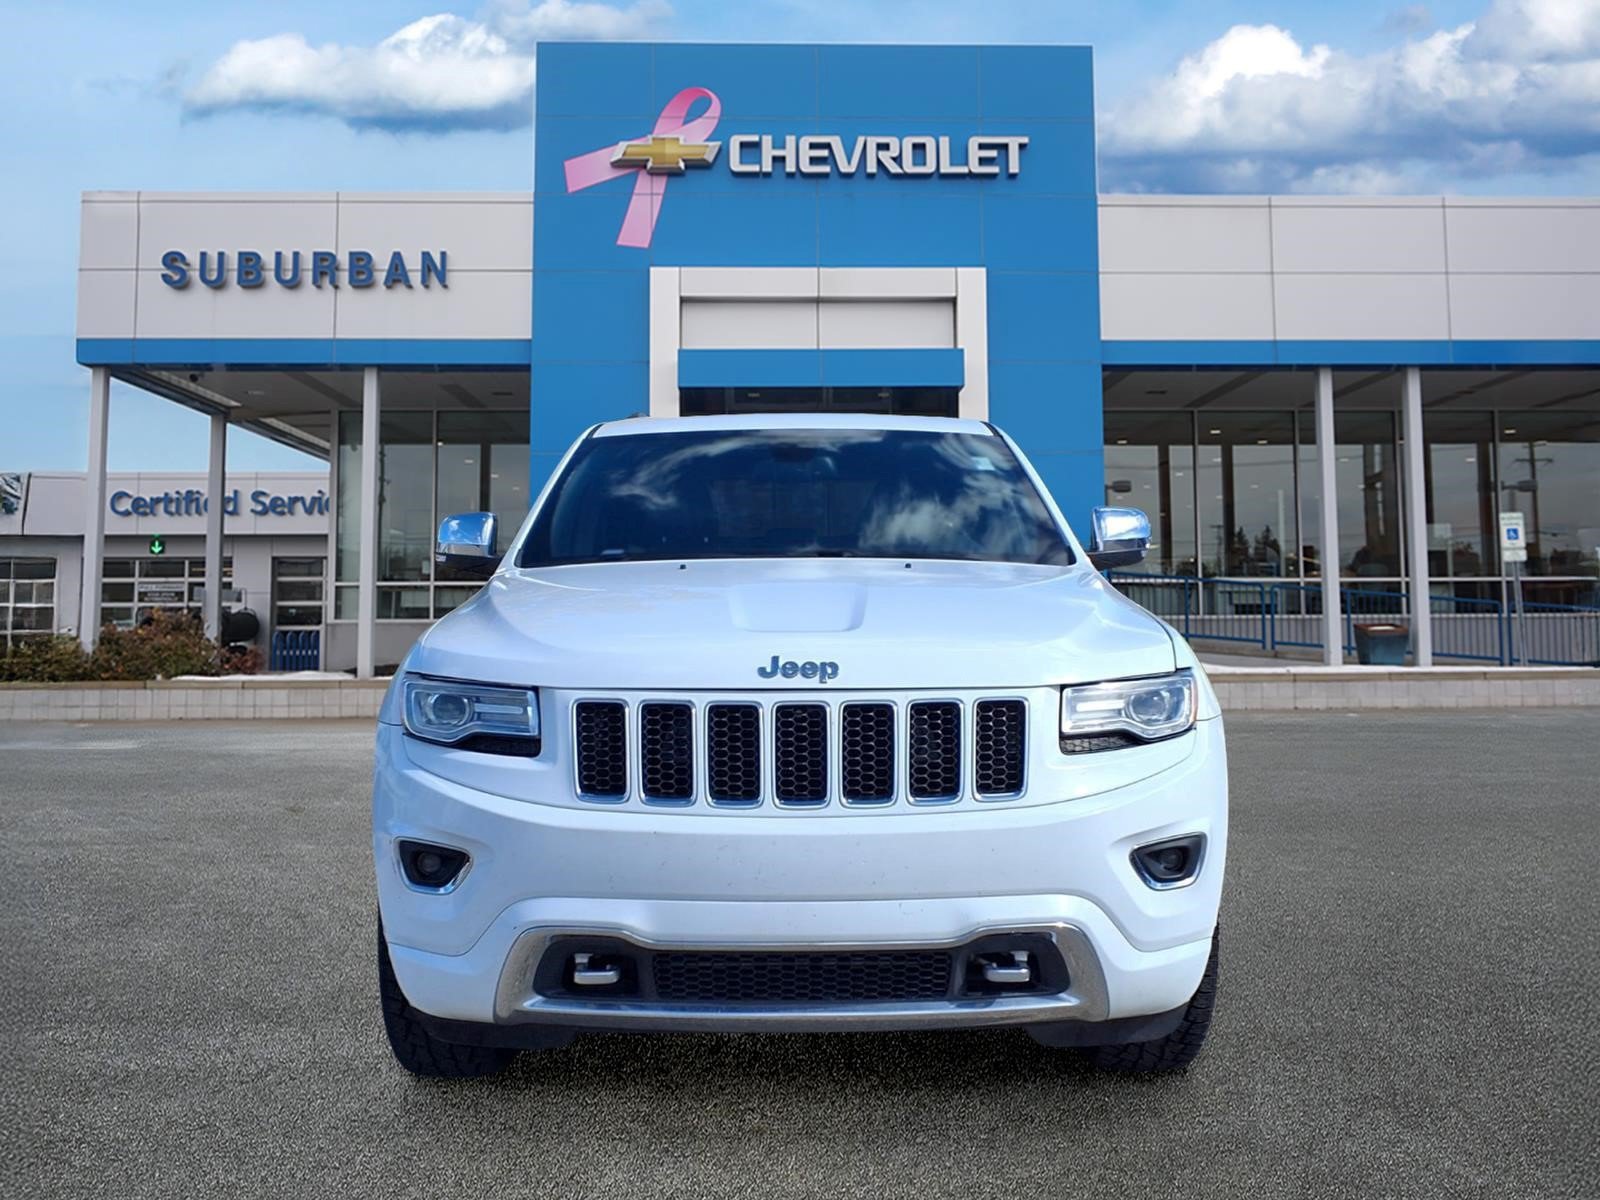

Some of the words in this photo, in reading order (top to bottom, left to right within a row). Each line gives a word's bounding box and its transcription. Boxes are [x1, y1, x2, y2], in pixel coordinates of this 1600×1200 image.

[729, 134, 1029, 176] CHEVROLET
[161, 250, 449, 289] SUBURBAN
[109, 490, 240, 516] Certifid
[250, 490, 329, 516] Servi
[757, 655, 839, 684] Jeep
